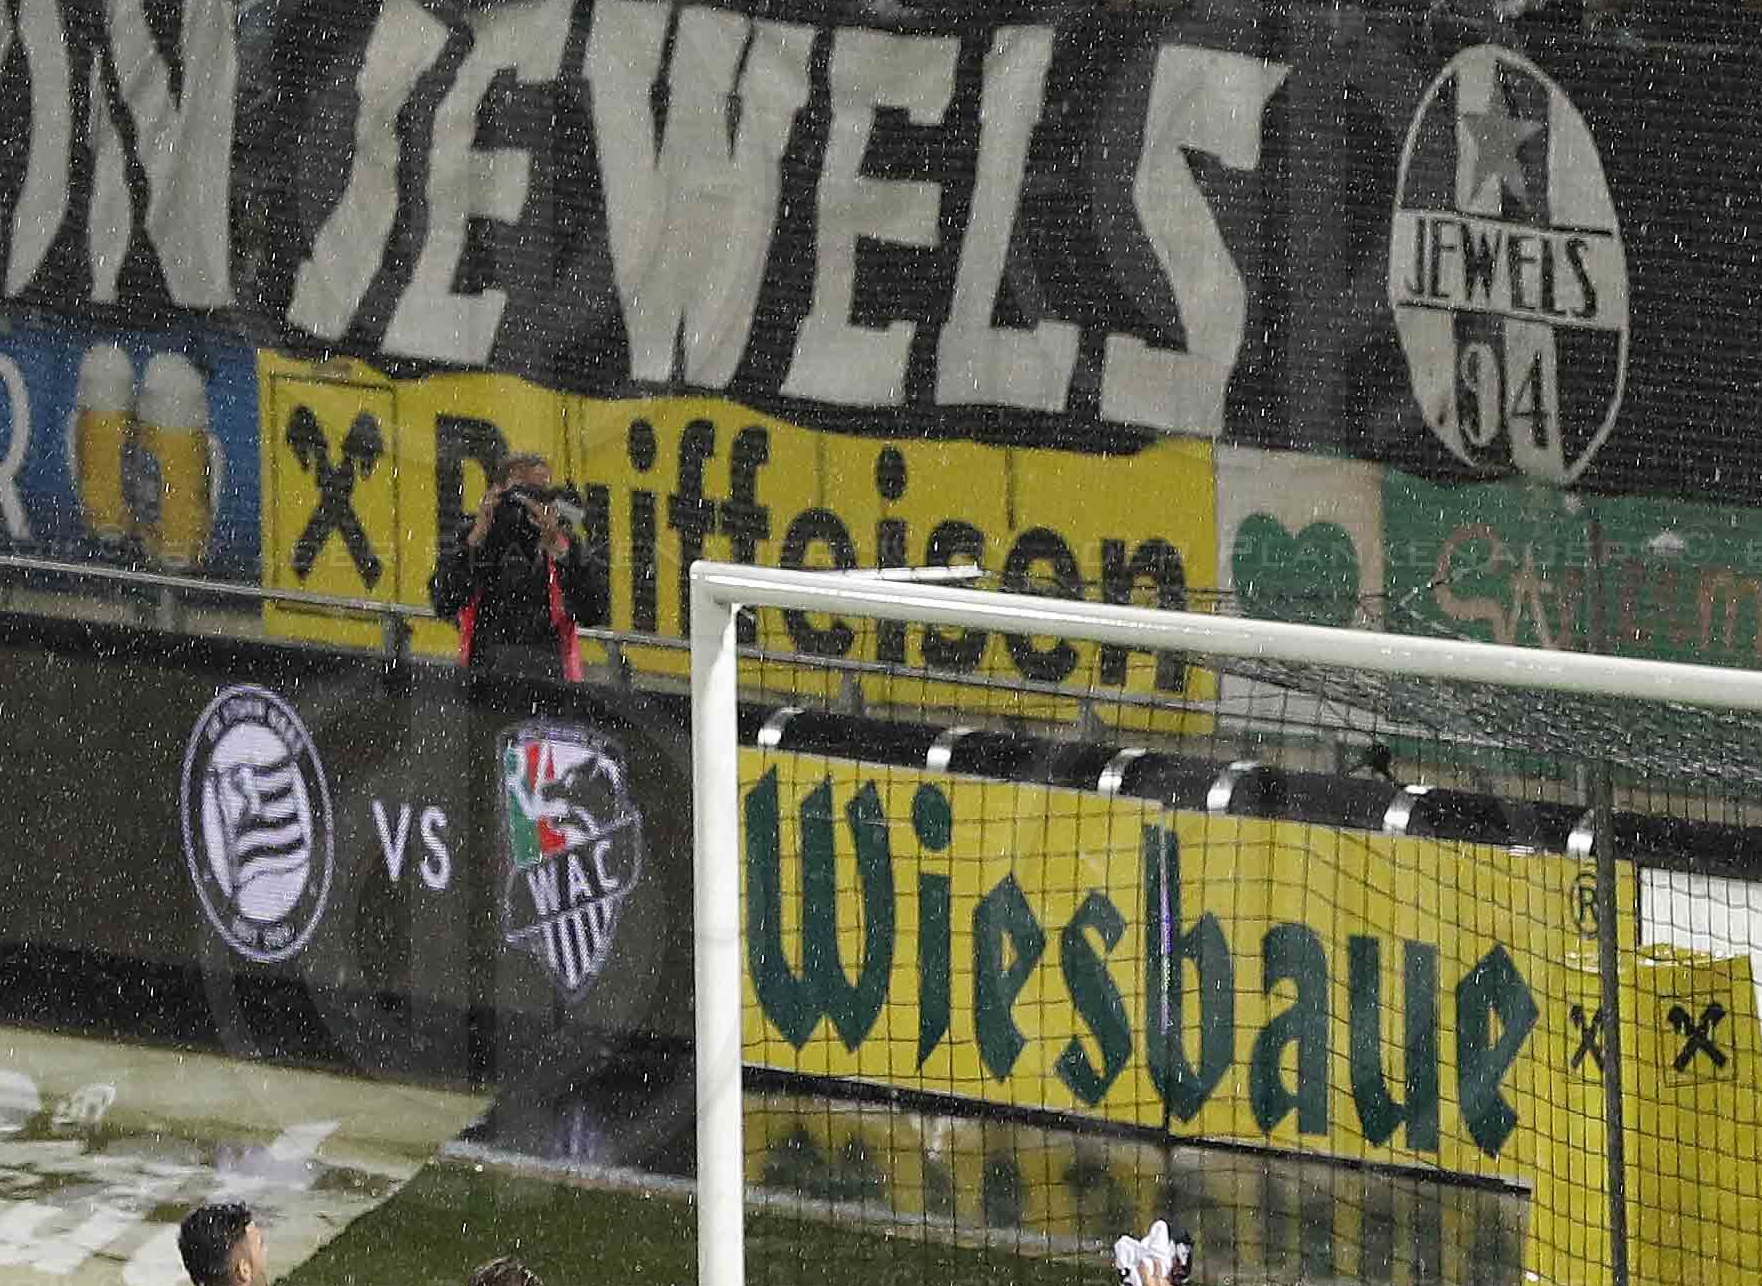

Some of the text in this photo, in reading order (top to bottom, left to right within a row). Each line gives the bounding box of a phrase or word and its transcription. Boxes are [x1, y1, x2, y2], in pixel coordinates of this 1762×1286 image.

[1403, 217, 1598, 319] JEWELS
[1455, 341, 1553, 451] 94
[437, 413, 1188, 694] Riffeisen
[372, 800, 452, 891] VS
[525, 839, 620, 915] WAC
[744, 762, 1541, 1159] Wiesbaue
